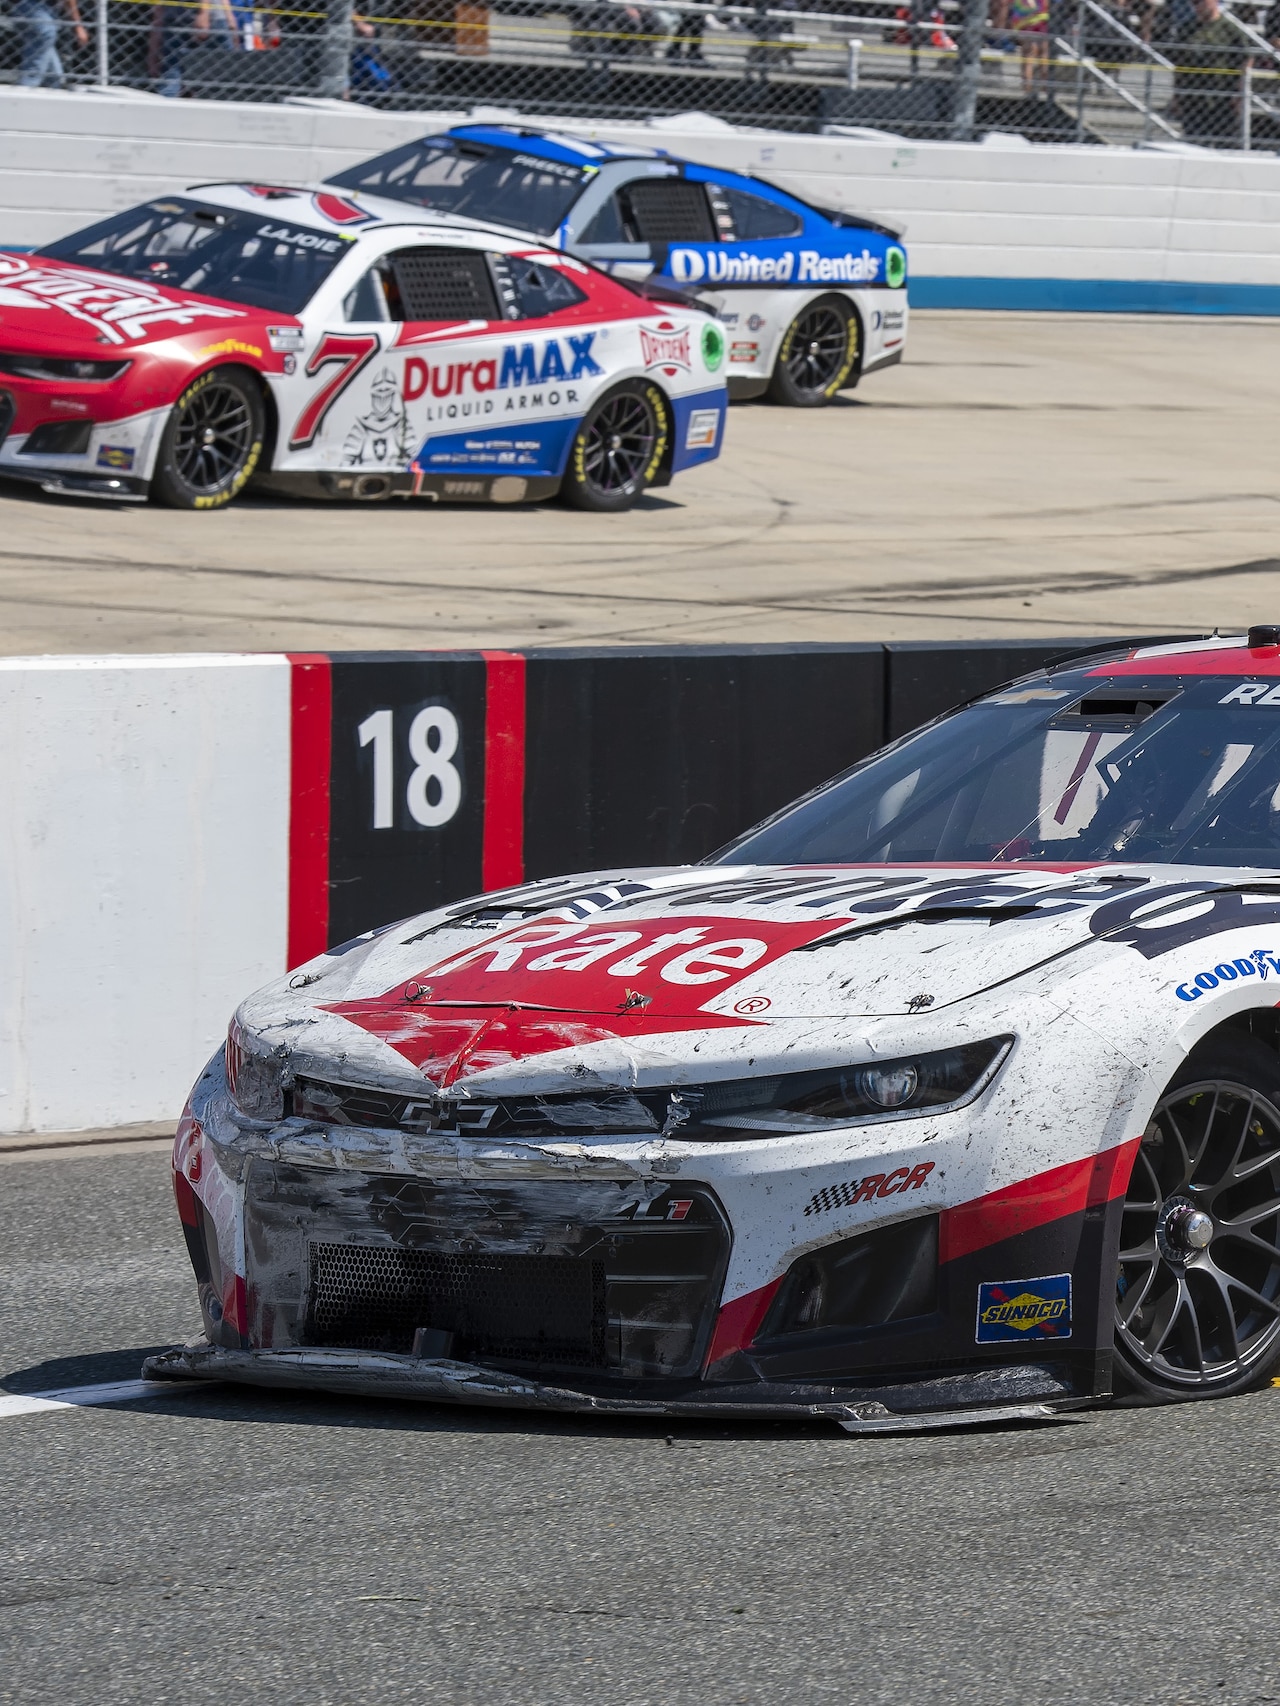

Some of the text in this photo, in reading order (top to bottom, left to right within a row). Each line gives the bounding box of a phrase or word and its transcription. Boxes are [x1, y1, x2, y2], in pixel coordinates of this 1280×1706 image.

[257, 224, 343, 254] LAJOIE
[707, 248, 879, 281] United Rentals
[402, 331, 607, 402] DuraMAX
[179, 370, 216, 409] EAGLE
[289, 332, 380, 451] 7
[426, 389, 580, 422] LIQUID ARMOR
[357, 704, 462, 830] 18
[424, 922, 769, 986] Rate
[851, 1161, 936, 1204] RCR
[985, 1299, 1065, 1324] SUNOCO
